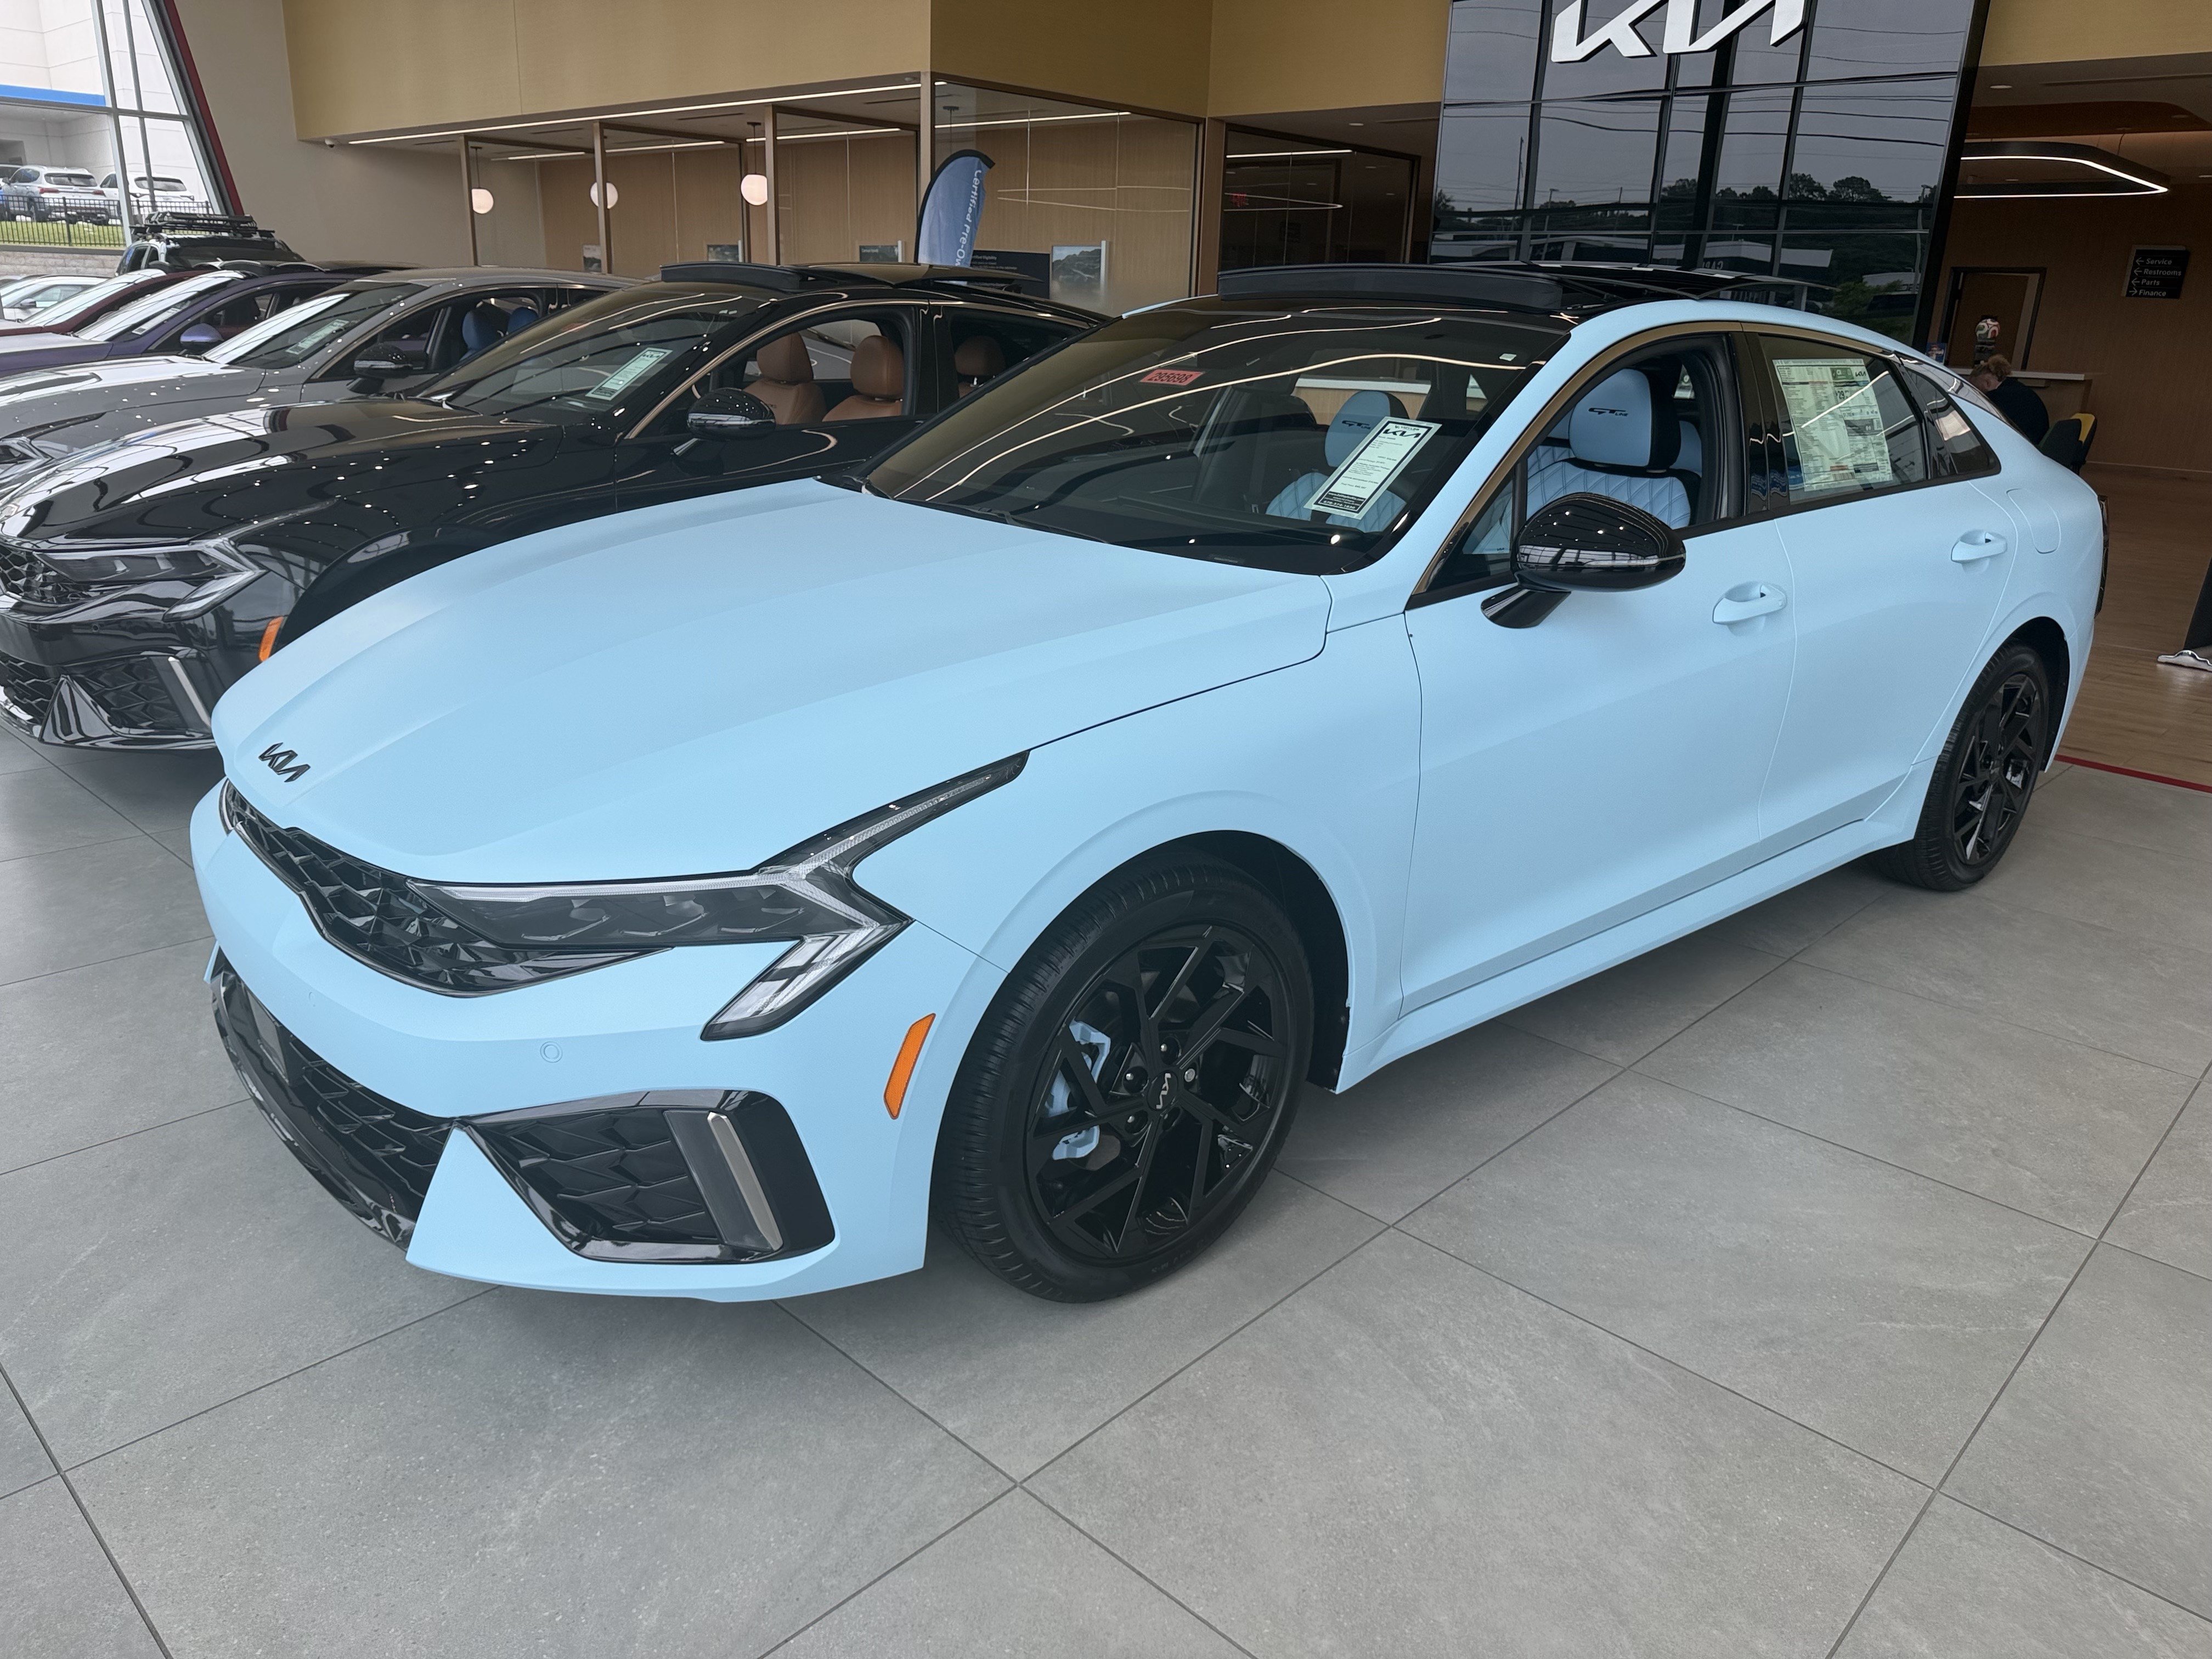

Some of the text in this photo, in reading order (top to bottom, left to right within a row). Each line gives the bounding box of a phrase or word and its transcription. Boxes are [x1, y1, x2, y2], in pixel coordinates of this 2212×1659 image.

[1551, 0, 1804, 62] KIA
[966, 170, 981, 223] Certified
[1148, 372, 1193, 383] 295698
[1383, 428, 1421, 438] KIA
[258, 742, 311, 783] KIA
[1156, 1073, 1172, 1109] KIA
